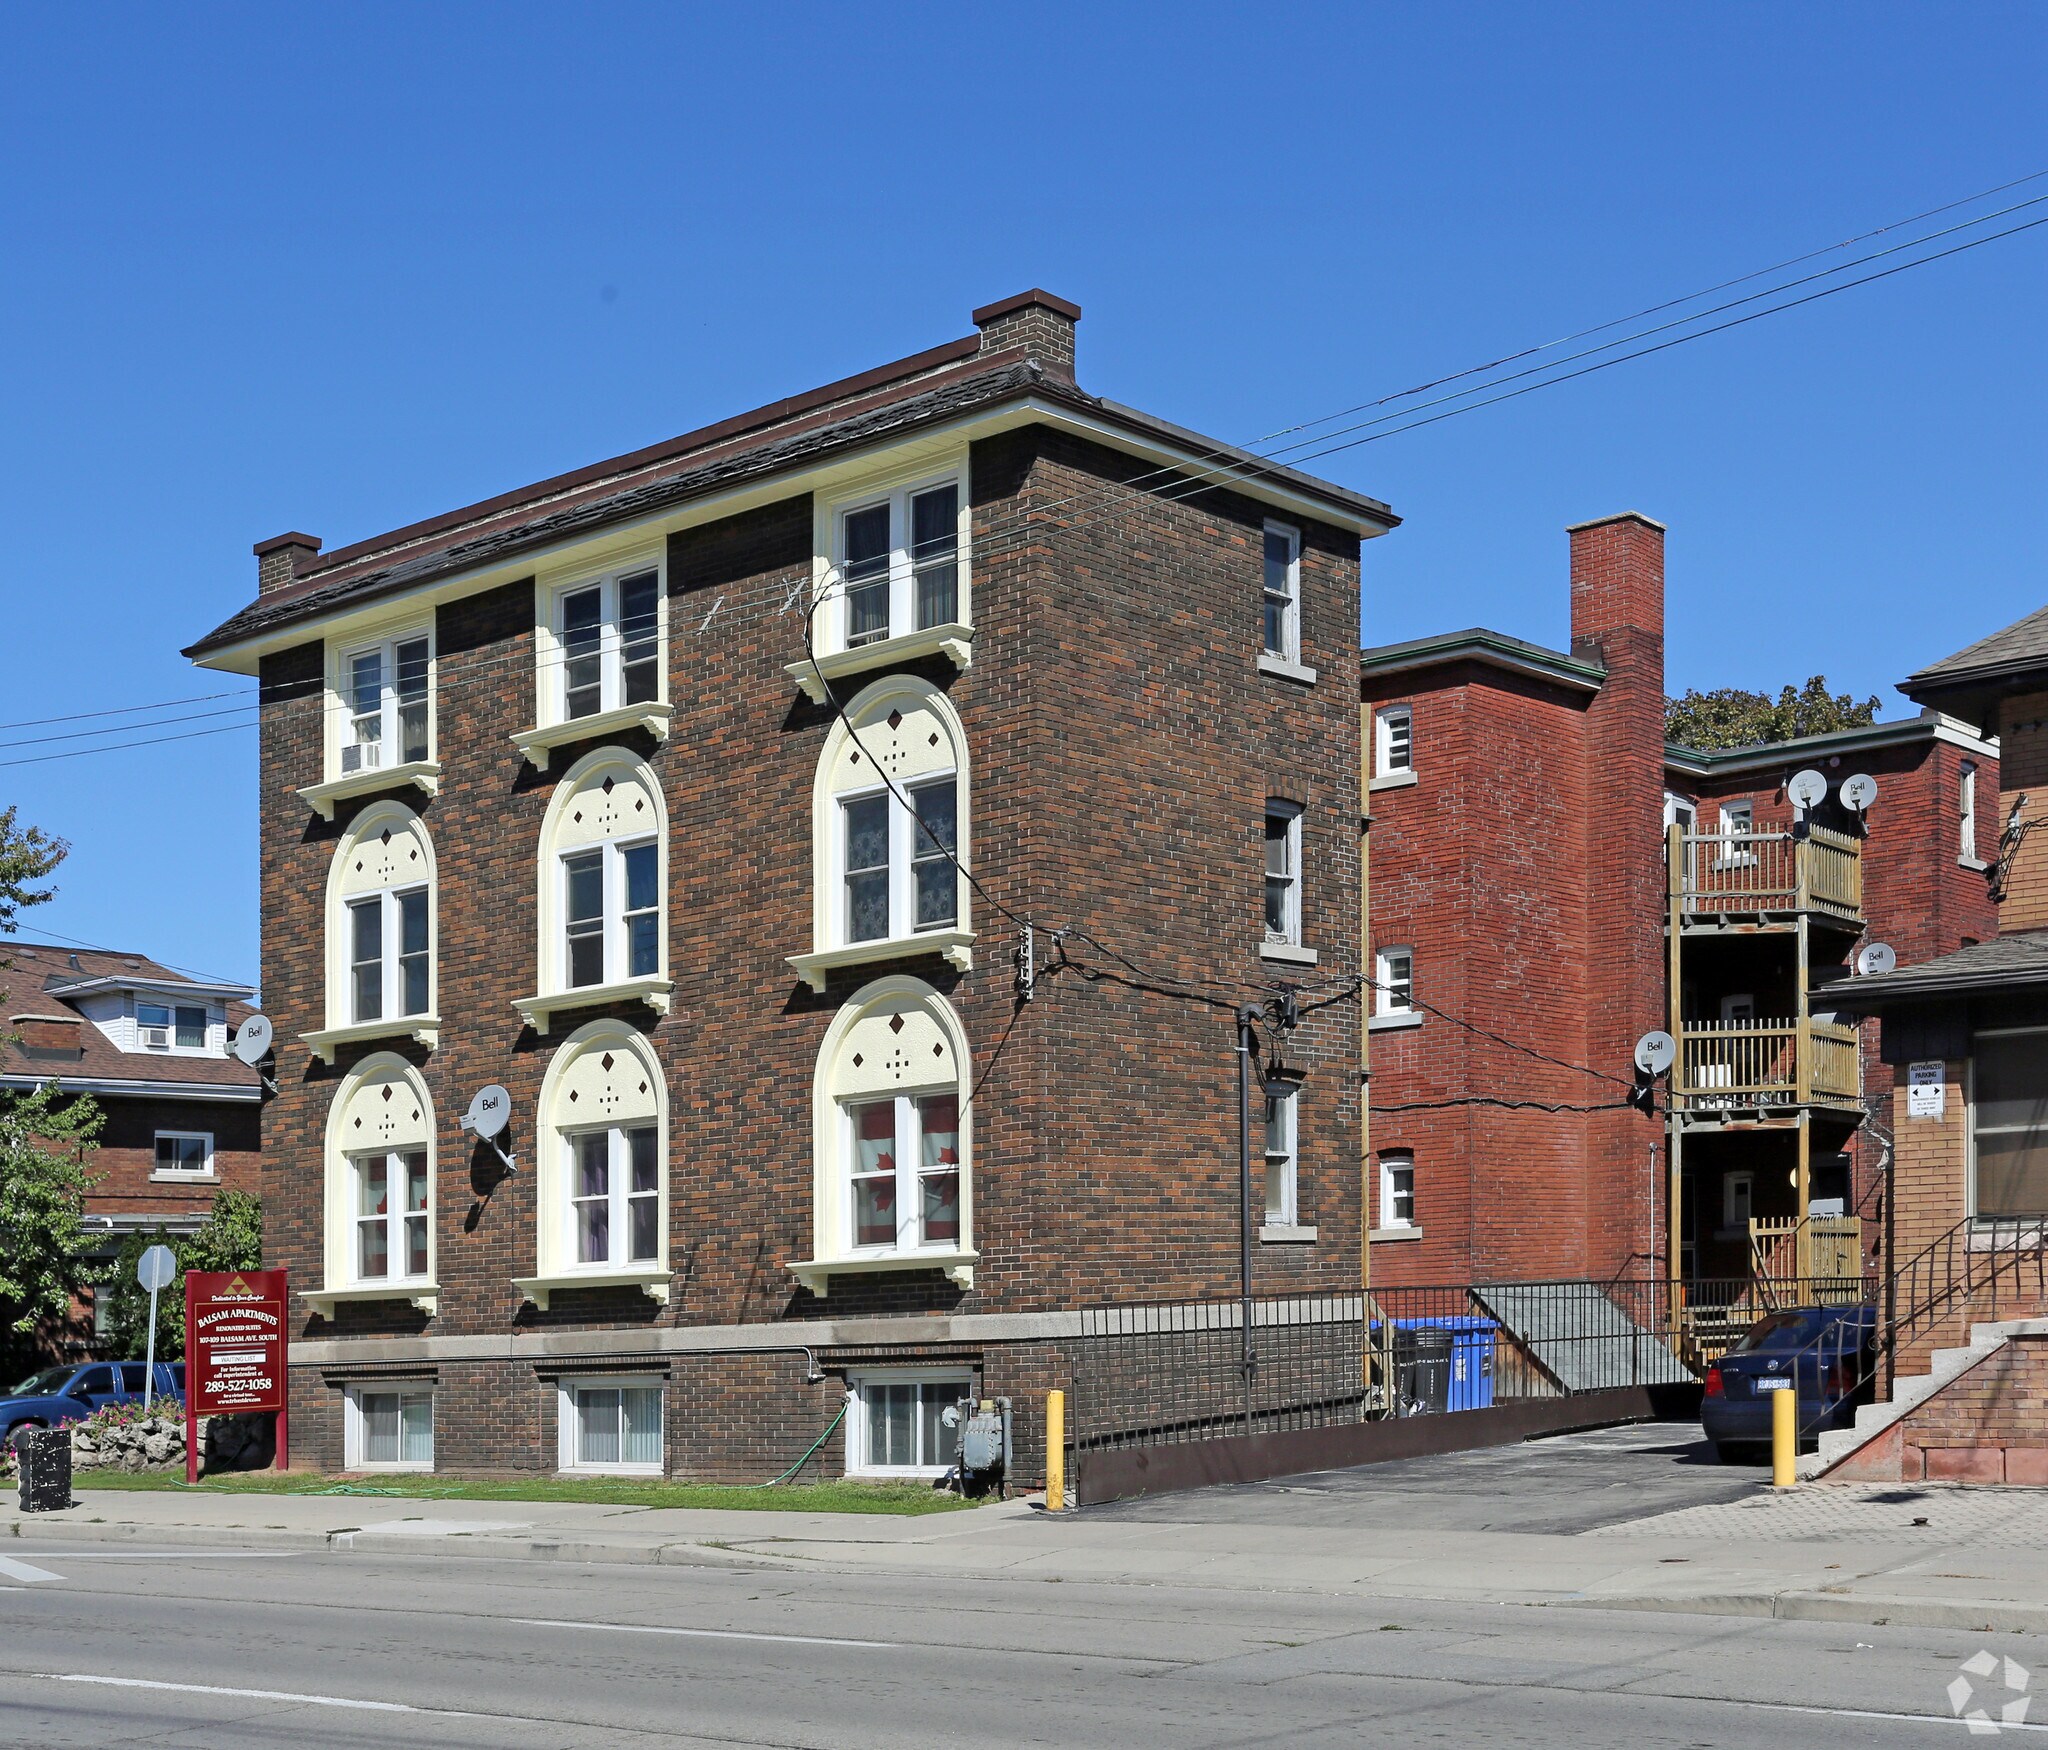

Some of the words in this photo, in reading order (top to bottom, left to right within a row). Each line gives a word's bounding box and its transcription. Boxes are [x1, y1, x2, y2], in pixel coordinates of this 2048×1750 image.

[1868, 950, 1884, 961] Bell
[248, 1025, 263, 1038] Bell
[1647, 1041, 1663, 1051] Bell
[1910, 1063, 1942, 1072] AUTHORIZED
[1915, 1071, 1937, 1079] PARKING
[482, 1096, 499, 1111] Bell
[197, 1309, 229, 1328] BALSAM
[230, 1309, 278, 1326] APARTMENTS
[199, 1336, 219, 1344] 107-109
[220, 1335, 244, 1343] BALSAM
[204, 1378, 273, 1393] 289-527-1058
